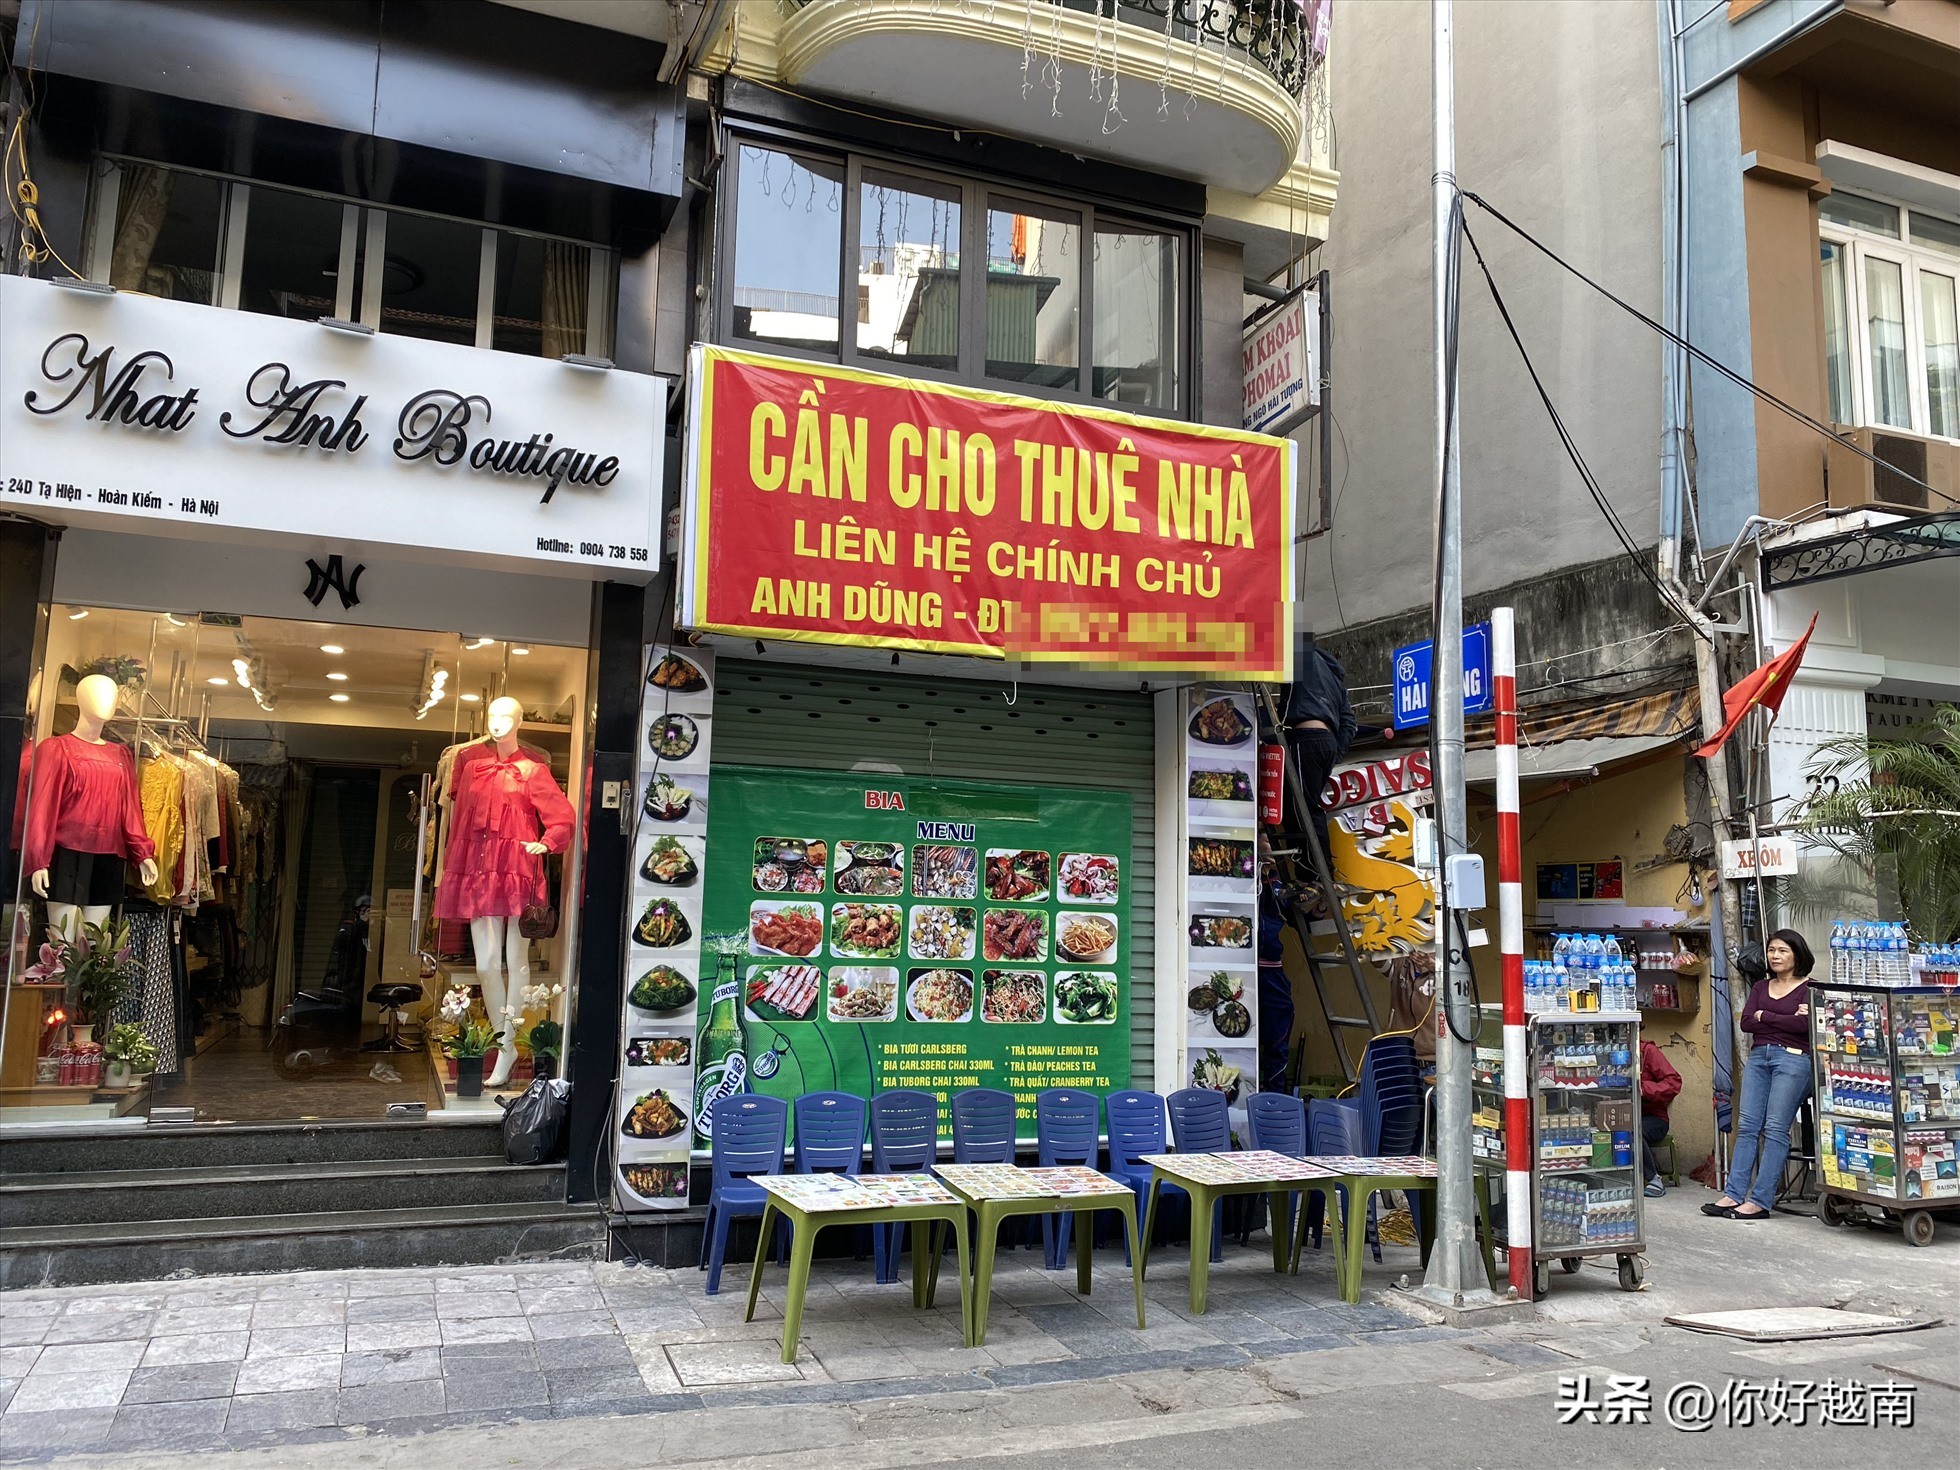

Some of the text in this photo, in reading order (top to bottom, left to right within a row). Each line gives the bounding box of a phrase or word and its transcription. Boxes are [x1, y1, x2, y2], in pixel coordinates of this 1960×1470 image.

[1256, 308, 1301, 366] KHOAI
[24, 333, 620, 505] Nhat Anh Boutique
[748, 378, 1256, 550] CẦN CHO THUÊ NHÀ
[8, 478, 33, 494] 24D
[39, 481, 51, 499] Tạ
[98, 488, 128, 505] Hoàn
[181, 497, 196, 513] Hà
[200, 500, 220, 517] Nội
[580, 542, 604, 557] 0904
[609, 545, 626, 559] 738
[630, 548, 648, 562] 558
[793, 515, 1222, 599] LIÊN HỆ CHÍNH CHỦ
[750, 577, 831, 619] ANH
[843, 580, 942, 630] DŨNG
[1402, 677, 1427, 713] HÀI
[865, 789, 905, 811] BIA
[916, 821, 976, 843] MENU
[1760, 844, 1783, 867] ÔM
[884, 1044, 898, 1054] BIA
[920, 1044, 967, 1054] CARLSBERG
[1011, 1044, 1025, 1055] TRÀ
[1057, 1046, 1083, 1055] LEMON
[1085, 1046, 1099, 1055] TEA
[883, 1060, 994, 1070] BIA CARLSBERG CHAI 330ML
[1010, 1060, 1025, 1071] TRÀ
[1047, 1062, 1080, 1071] PEACHES
[1082, 1062, 1096, 1071] TEA
[695, 1074, 718, 1110] COPENHAGEN
[883, 1076, 979, 1087] BIA TUBORG CHAI 330ML
[1010, 1076, 1025, 1087] TRÀ
[1050, 1077, 1094, 1087] CRANBERRY
[1096, 1077, 1110, 1087] TEA
